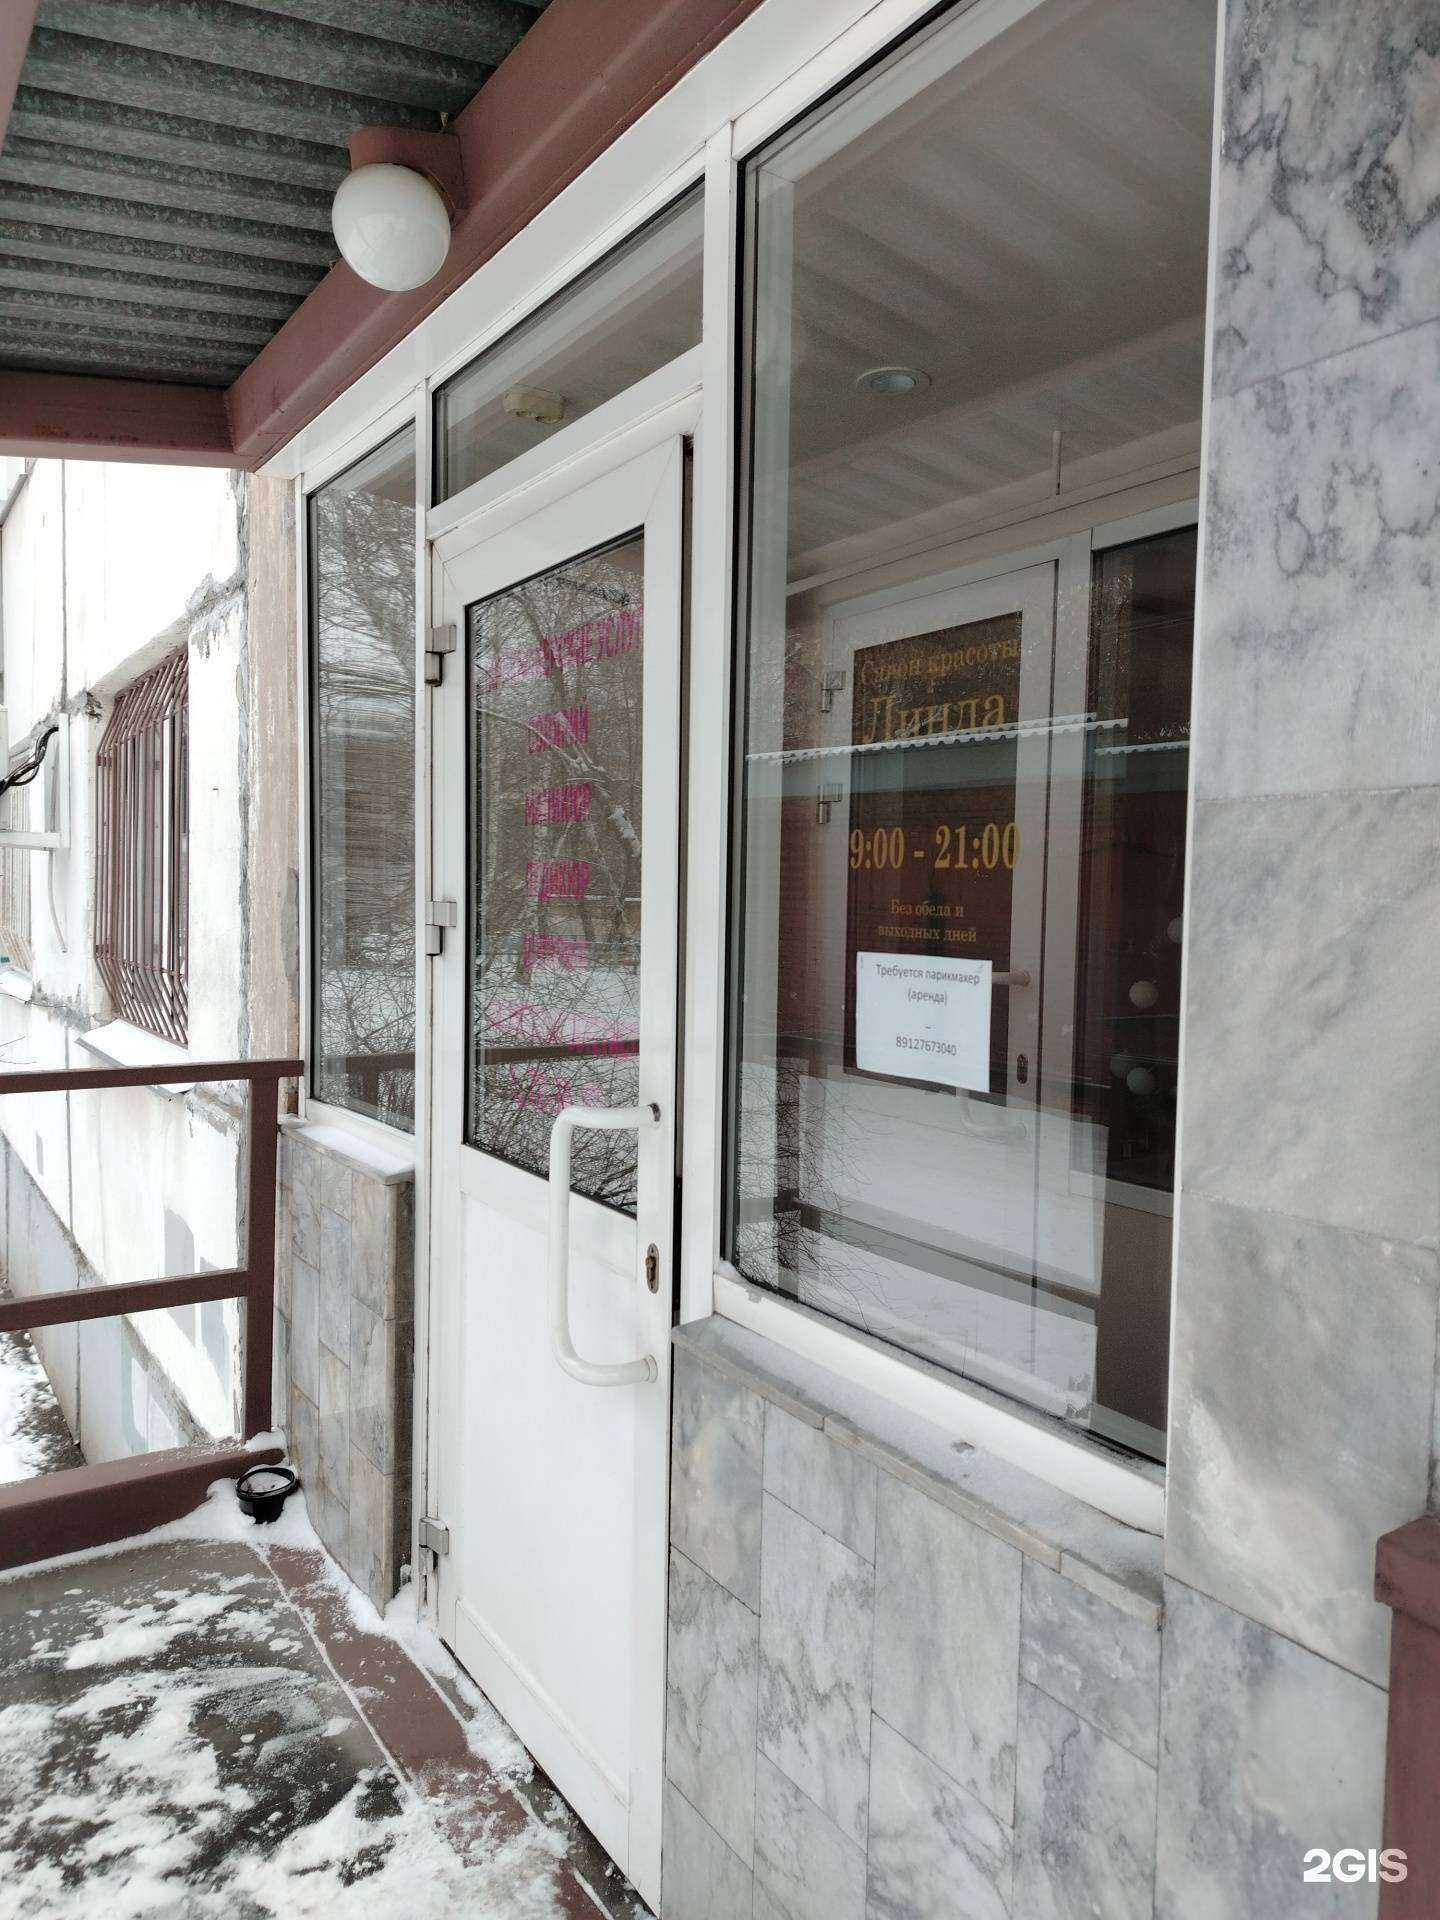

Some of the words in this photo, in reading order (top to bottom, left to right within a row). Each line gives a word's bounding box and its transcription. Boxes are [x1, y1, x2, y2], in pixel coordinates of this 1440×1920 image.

[863, 693, 1005, 745] Линда
[850, 827, 905, 870] 9:00
[935, 822, 1022, 870] 21:00
[891, 899, 911, 915] Без
[916, 901, 950, 917] обеда
[955, 905, 964, 917] и
[879, 925, 940, 942] выходных
[943, 926, 977, 942] дней
[876, 963, 924, 979] Требуется
[925, 969, 981, 986] парикмахер
[907, 987, 948, 1006] (аренда)
